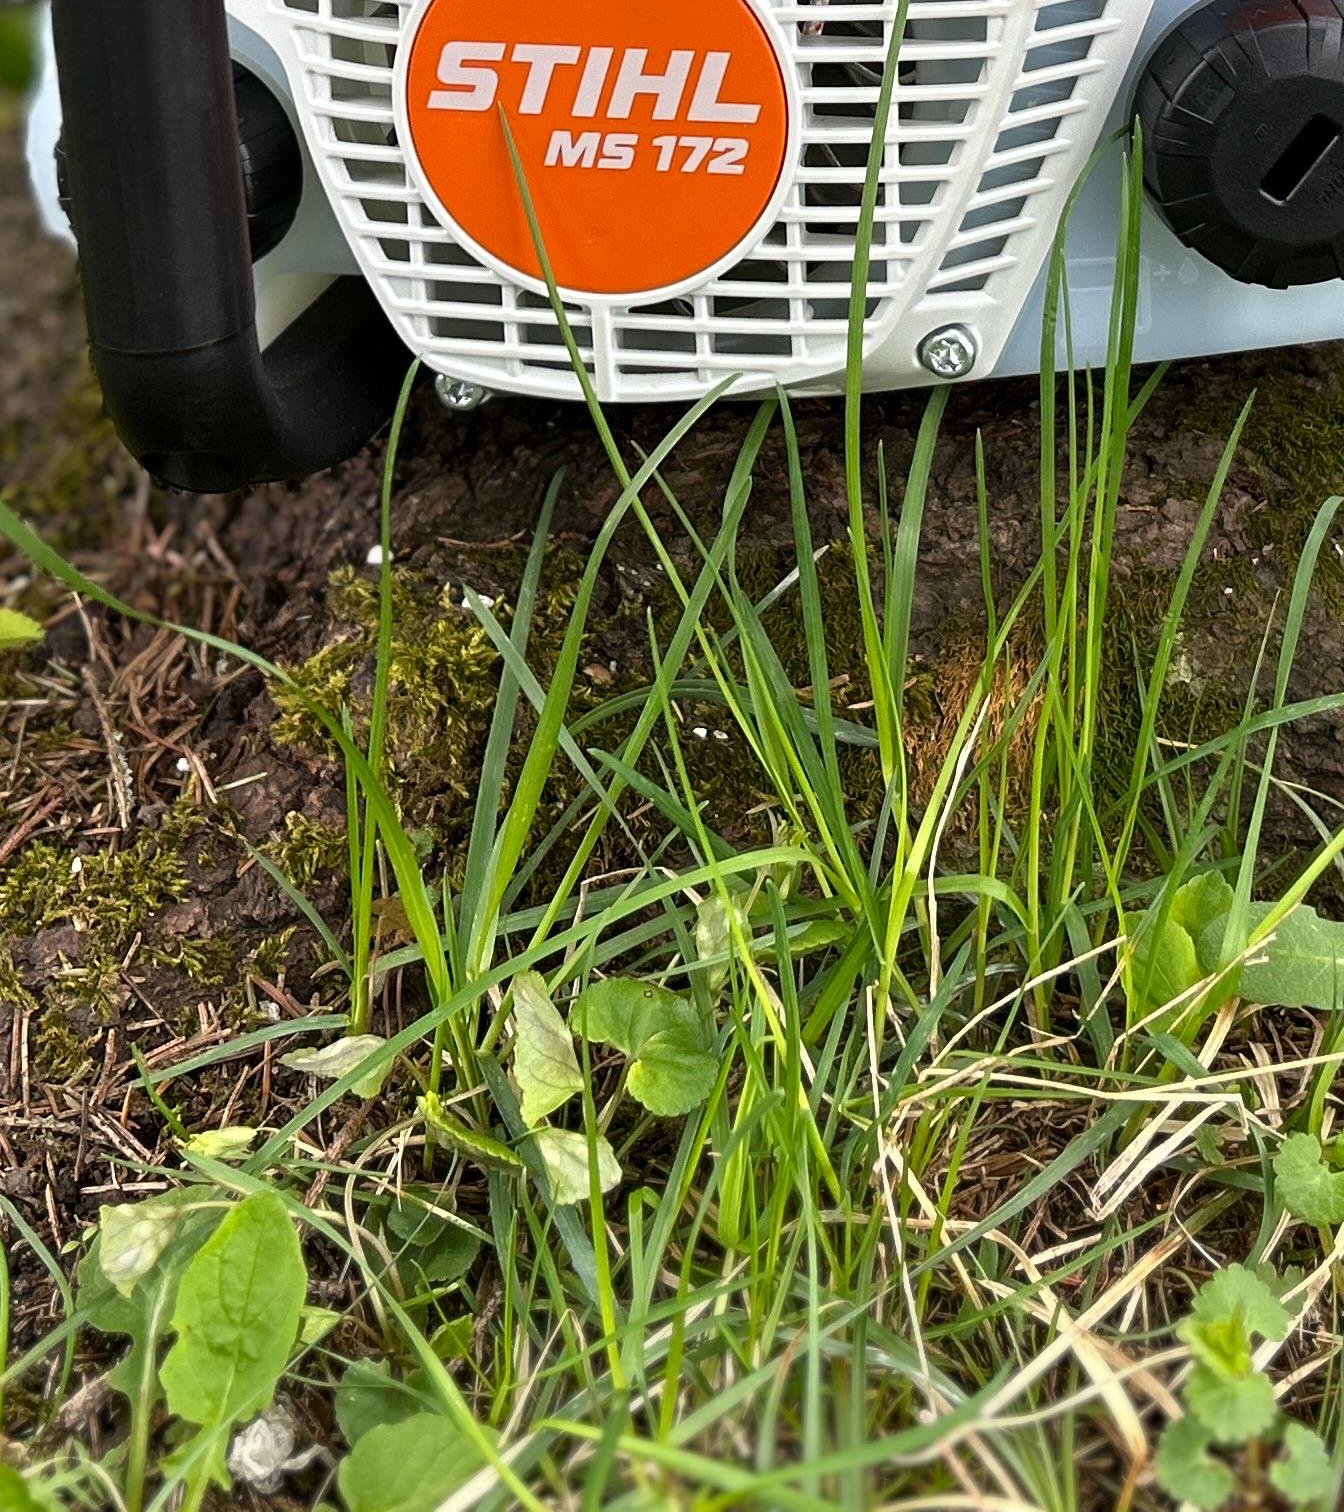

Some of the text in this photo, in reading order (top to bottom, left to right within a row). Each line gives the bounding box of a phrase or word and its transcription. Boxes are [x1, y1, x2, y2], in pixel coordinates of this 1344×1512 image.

[426, 40, 762, 125] STIHL
[544, 130, 750, 175] MS 172
